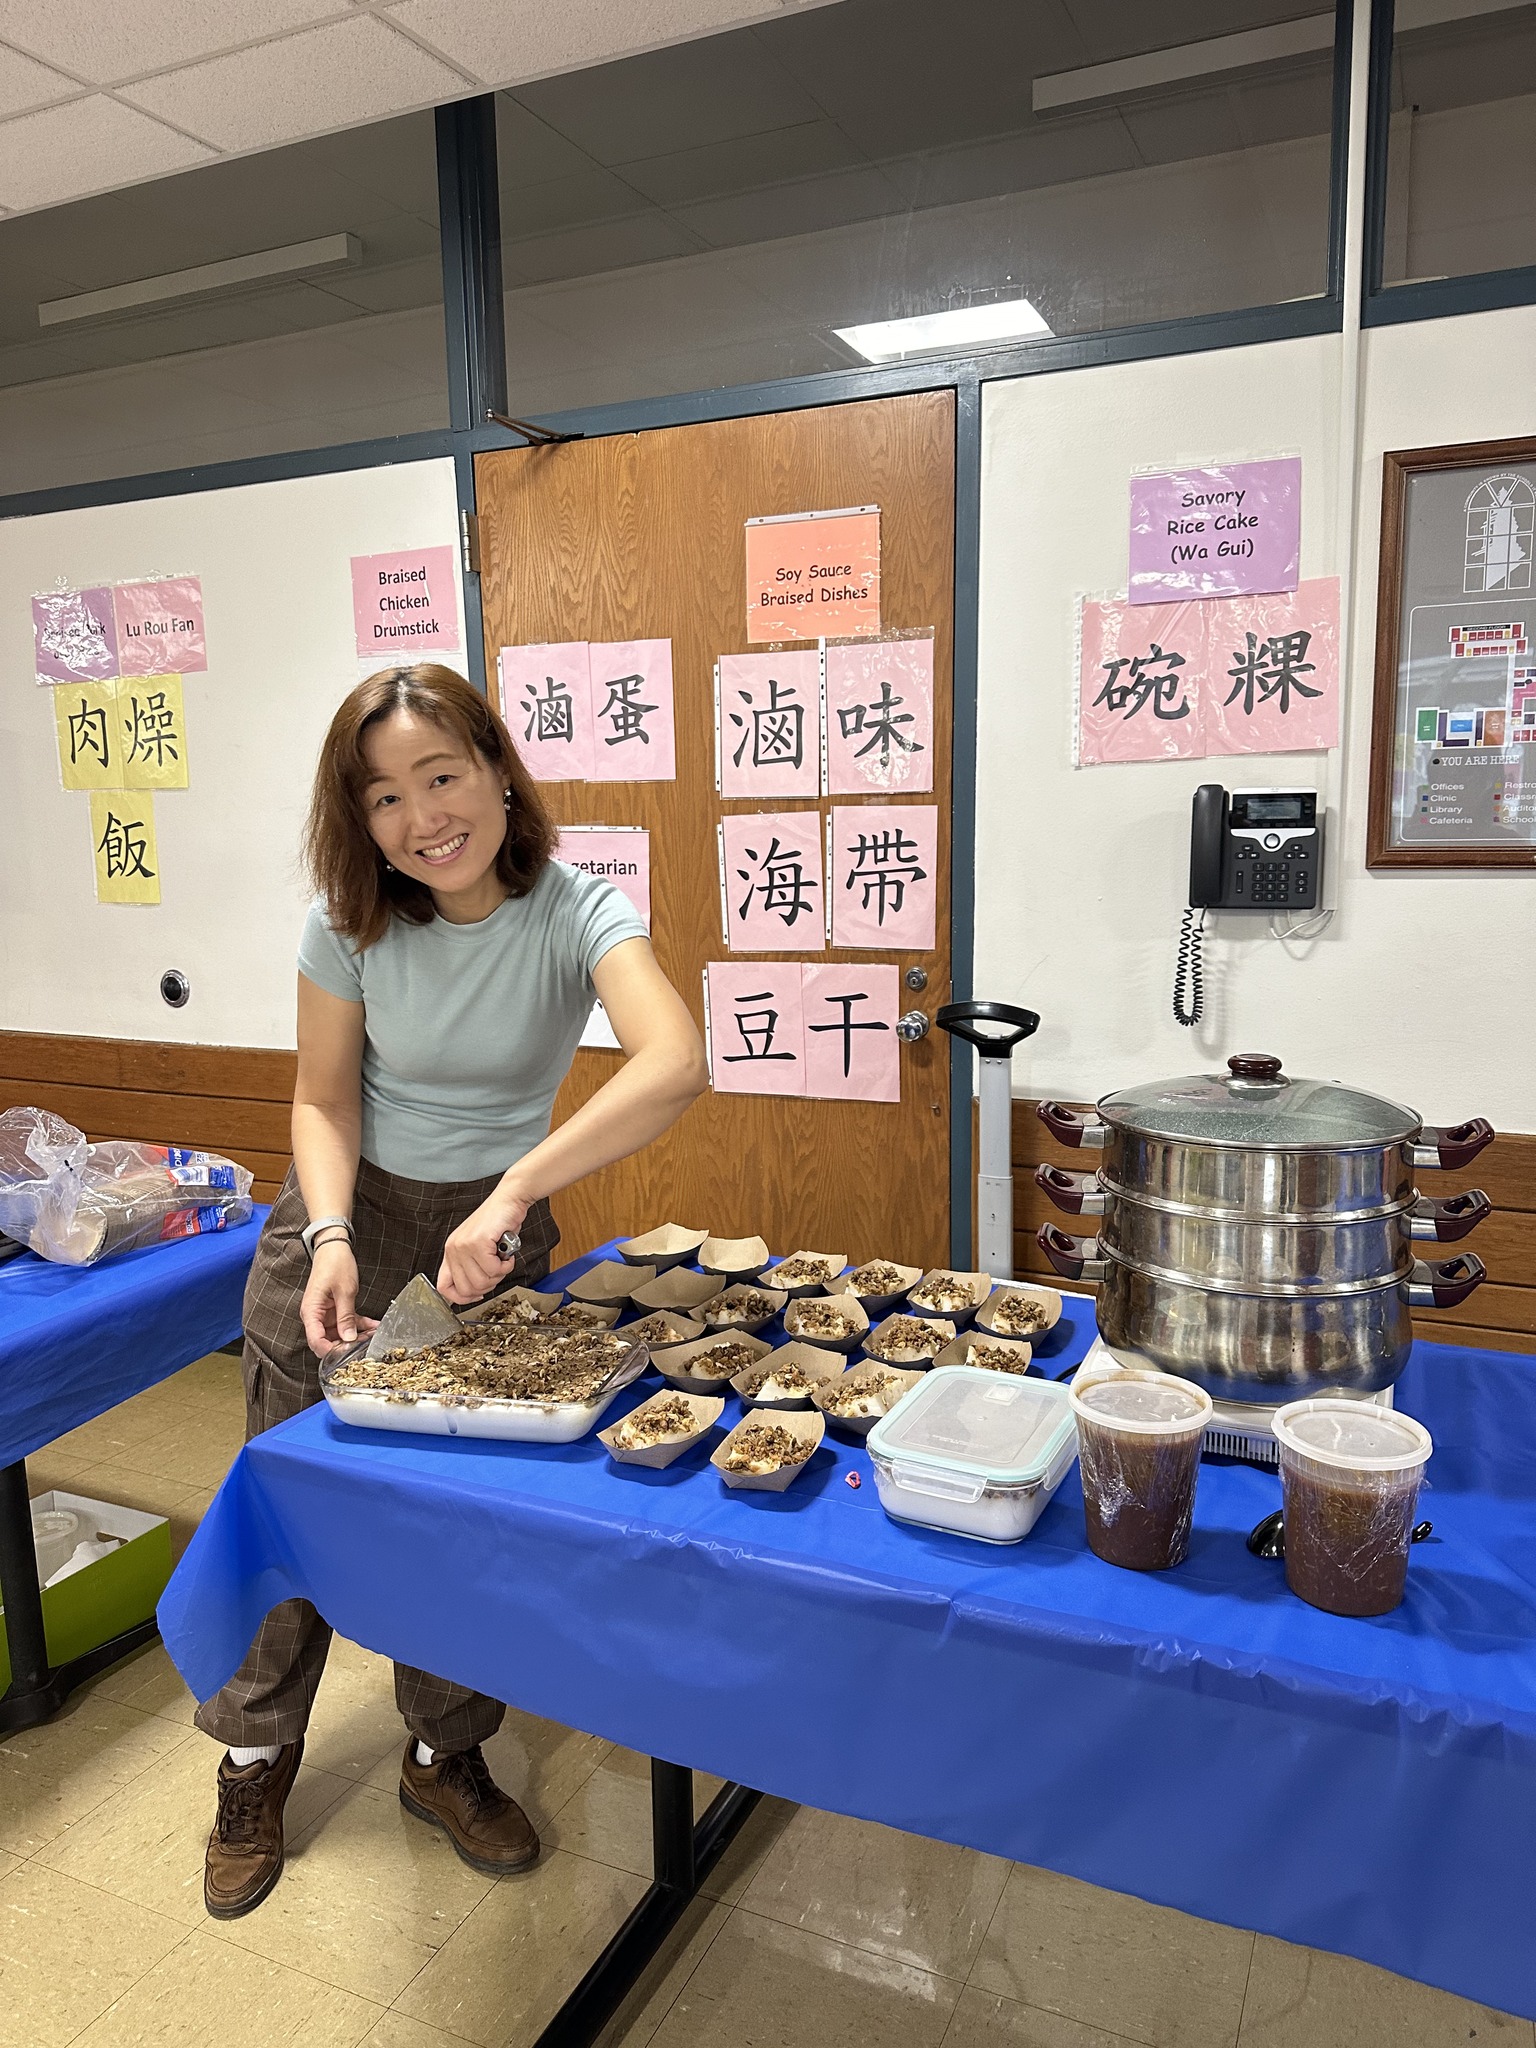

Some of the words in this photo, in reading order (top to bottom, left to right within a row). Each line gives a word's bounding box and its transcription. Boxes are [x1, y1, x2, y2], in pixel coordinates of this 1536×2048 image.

[1181, 490, 1246, 509] Savory
[1167, 518, 1205, 536] Rice
[1214, 512, 1259, 530] Cake
[1170, 544, 1209, 565] (Wa
[1217, 538, 1255, 559] Gui)
[378, 567, 427, 586] Braised
[775, 565, 803, 583] Soy
[809, 562, 852, 579] Sauce
[379, 594, 430, 611] Chicken
[760, 587, 815, 606] Braised
[820, 584, 869, 603] Dishes
[126, 623, 140, 637] Lu
[144, 621, 168, 636] Rou
[172, 618, 195, 633] Fan
[373, 618, 440, 639] Drumstick
[1092, 630, 1325, 721] 碗粿
[520, 674, 660, 746] 滷蛋
[67, 691, 179, 768] 肉燥
[728, 679, 925, 771] 滷味
[1441, 756, 1463, 766] YOU
[1464, 755, 1488, 765] ARE
[1490, 754, 1520, 765] HERE
[1431, 783, 1465, 791] Offices
[1430, 794, 1457, 802] Clinic
[1429, 816, 1473, 825] Cafeteria
[1430, 806, 1463, 814] Library
[97, 811, 156, 879] 飯
[569, 859, 638, 875] etarian
[737, 828, 927, 928] 海帶
[722, 991, 889, 1079] 豆干
